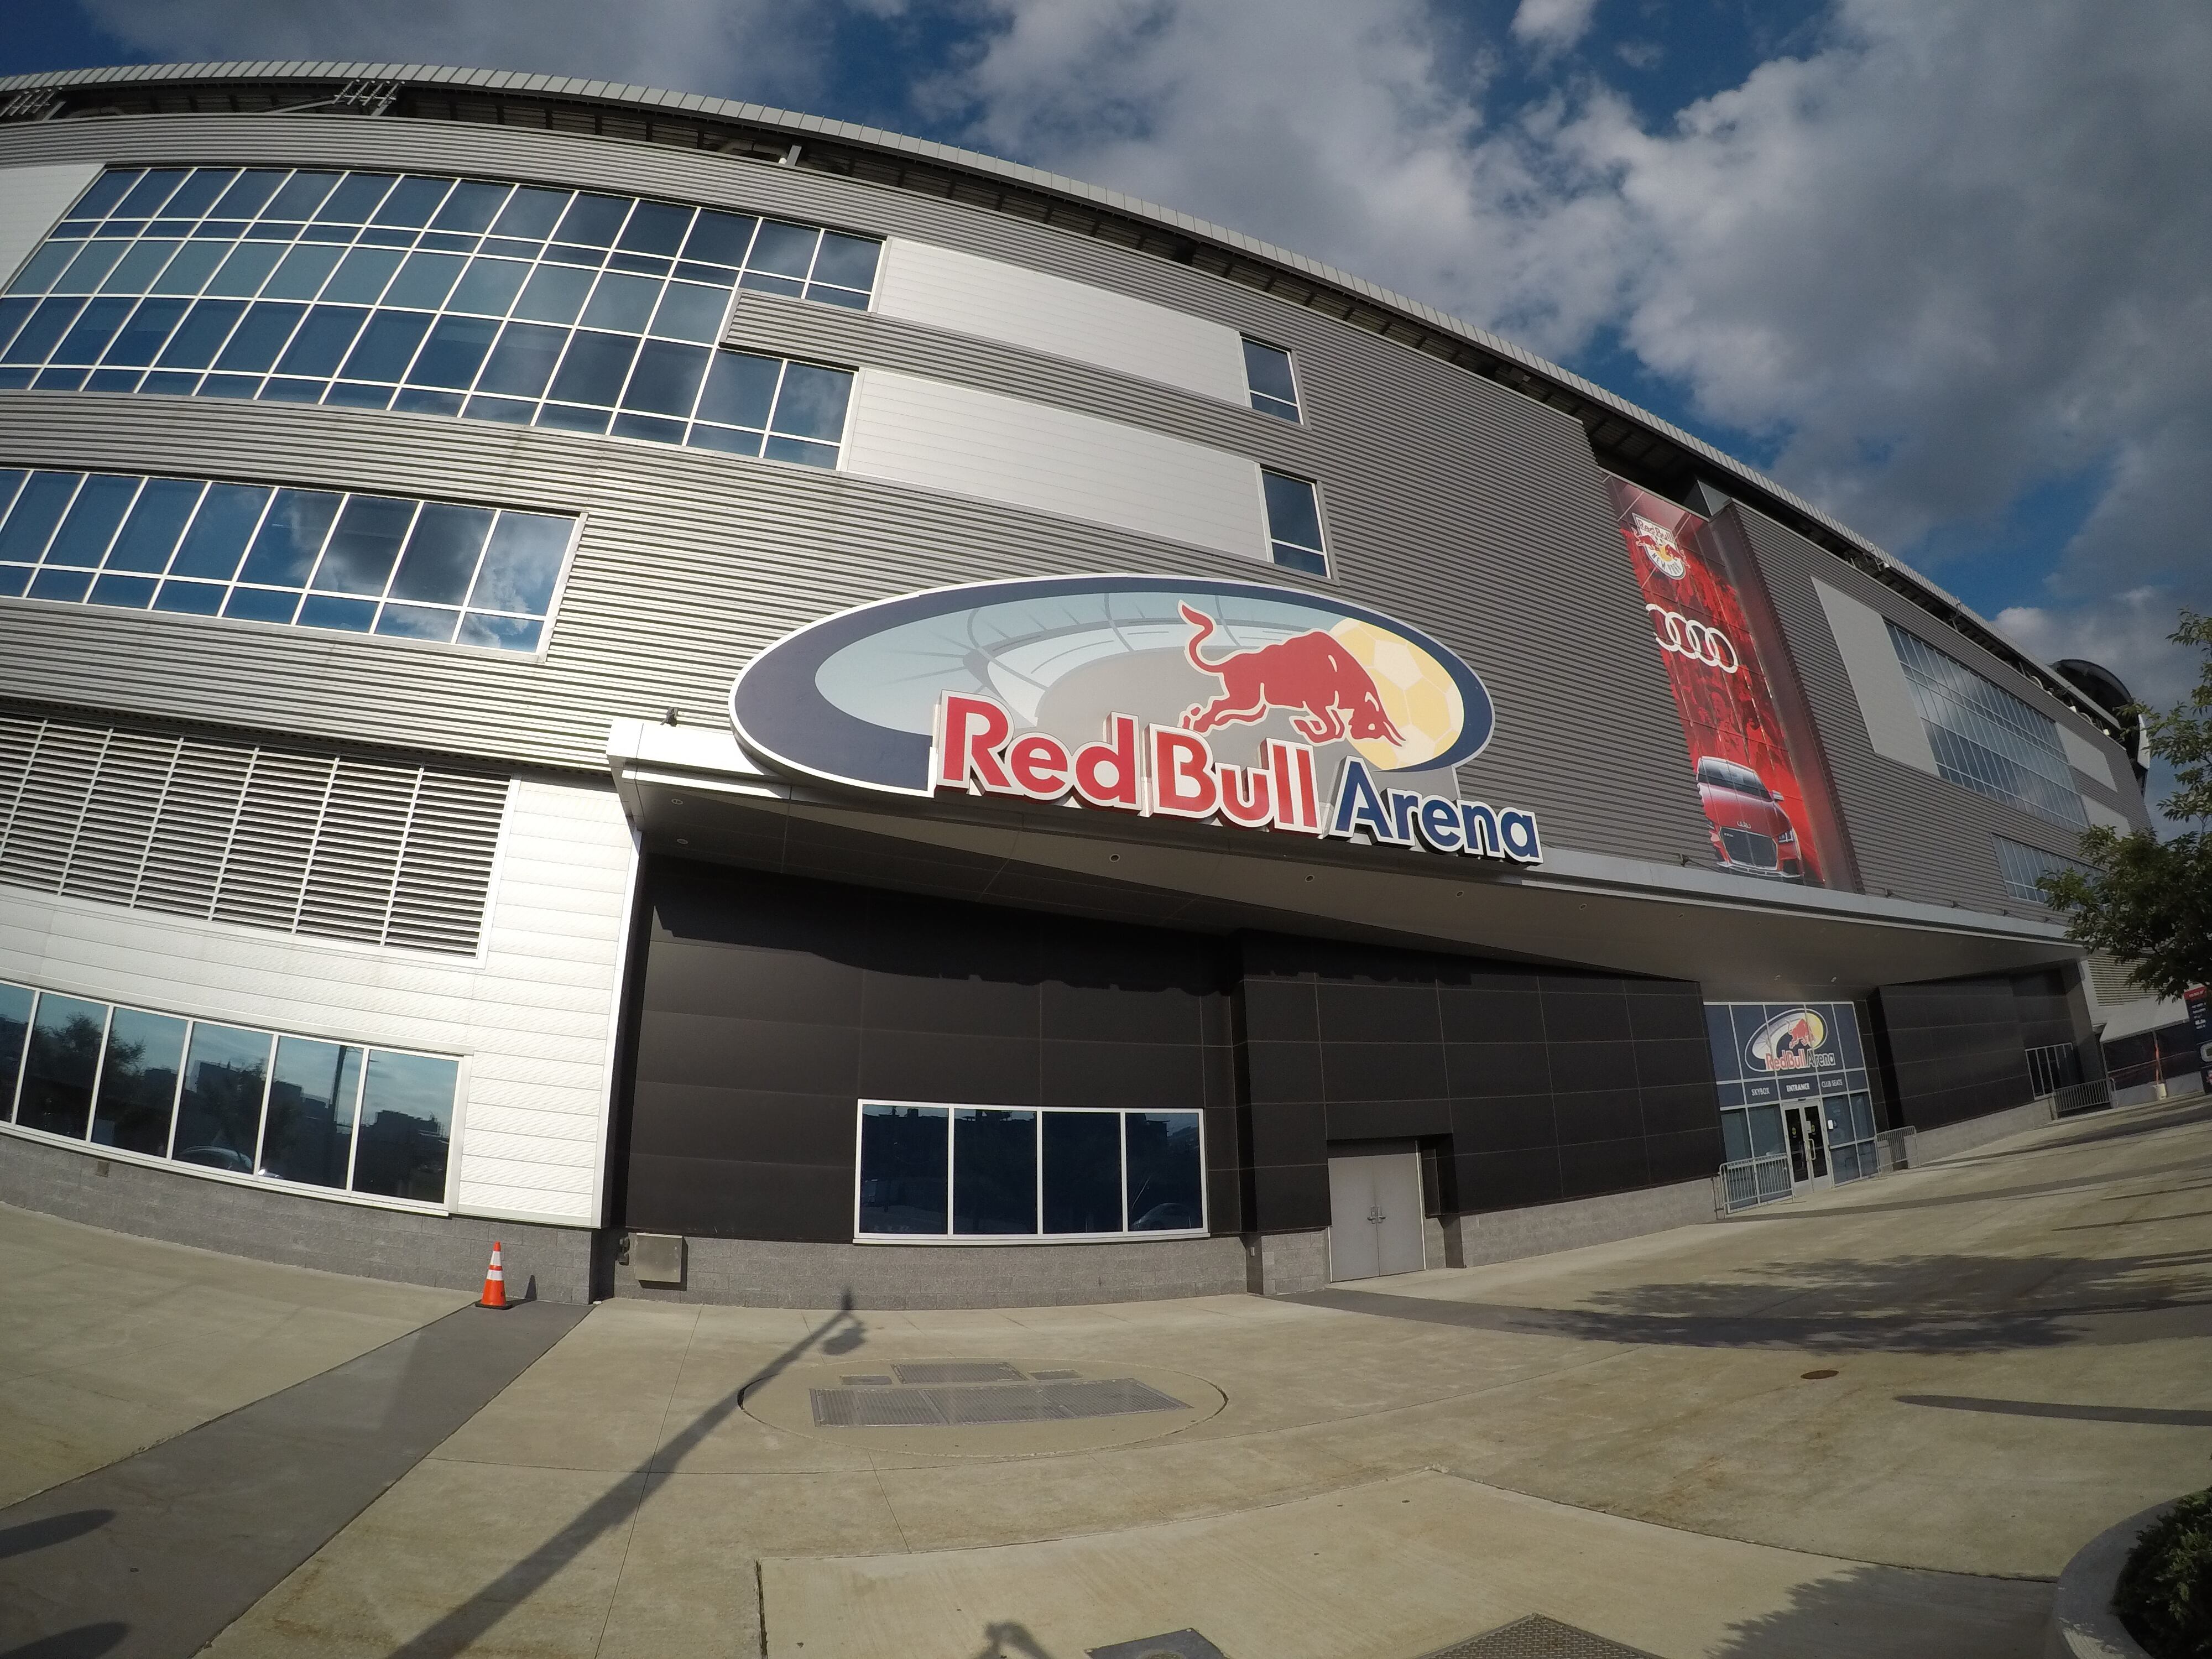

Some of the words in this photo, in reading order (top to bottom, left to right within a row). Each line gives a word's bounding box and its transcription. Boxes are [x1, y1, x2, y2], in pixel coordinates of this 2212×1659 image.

[1637, 519, 1655, 535] Red
[1655, 527, 1673, 541] Bull
[1651, 552, 1666, 570] NEW
[942, 691, 1139, 807] Red
[1153, 728, 1320, 834] Bull
[1331, 758, 1542, 863] Arena
[1765, 1050, 1786, 1070] Red
[1786, 1048, 1807, 1068] Bull
[1807, 1050, 1835, 1067] Arena
[1751, 1087, 1770, 1096] SKYBOX
[1786, 1083, 1810, 1092] ENTRANCE
